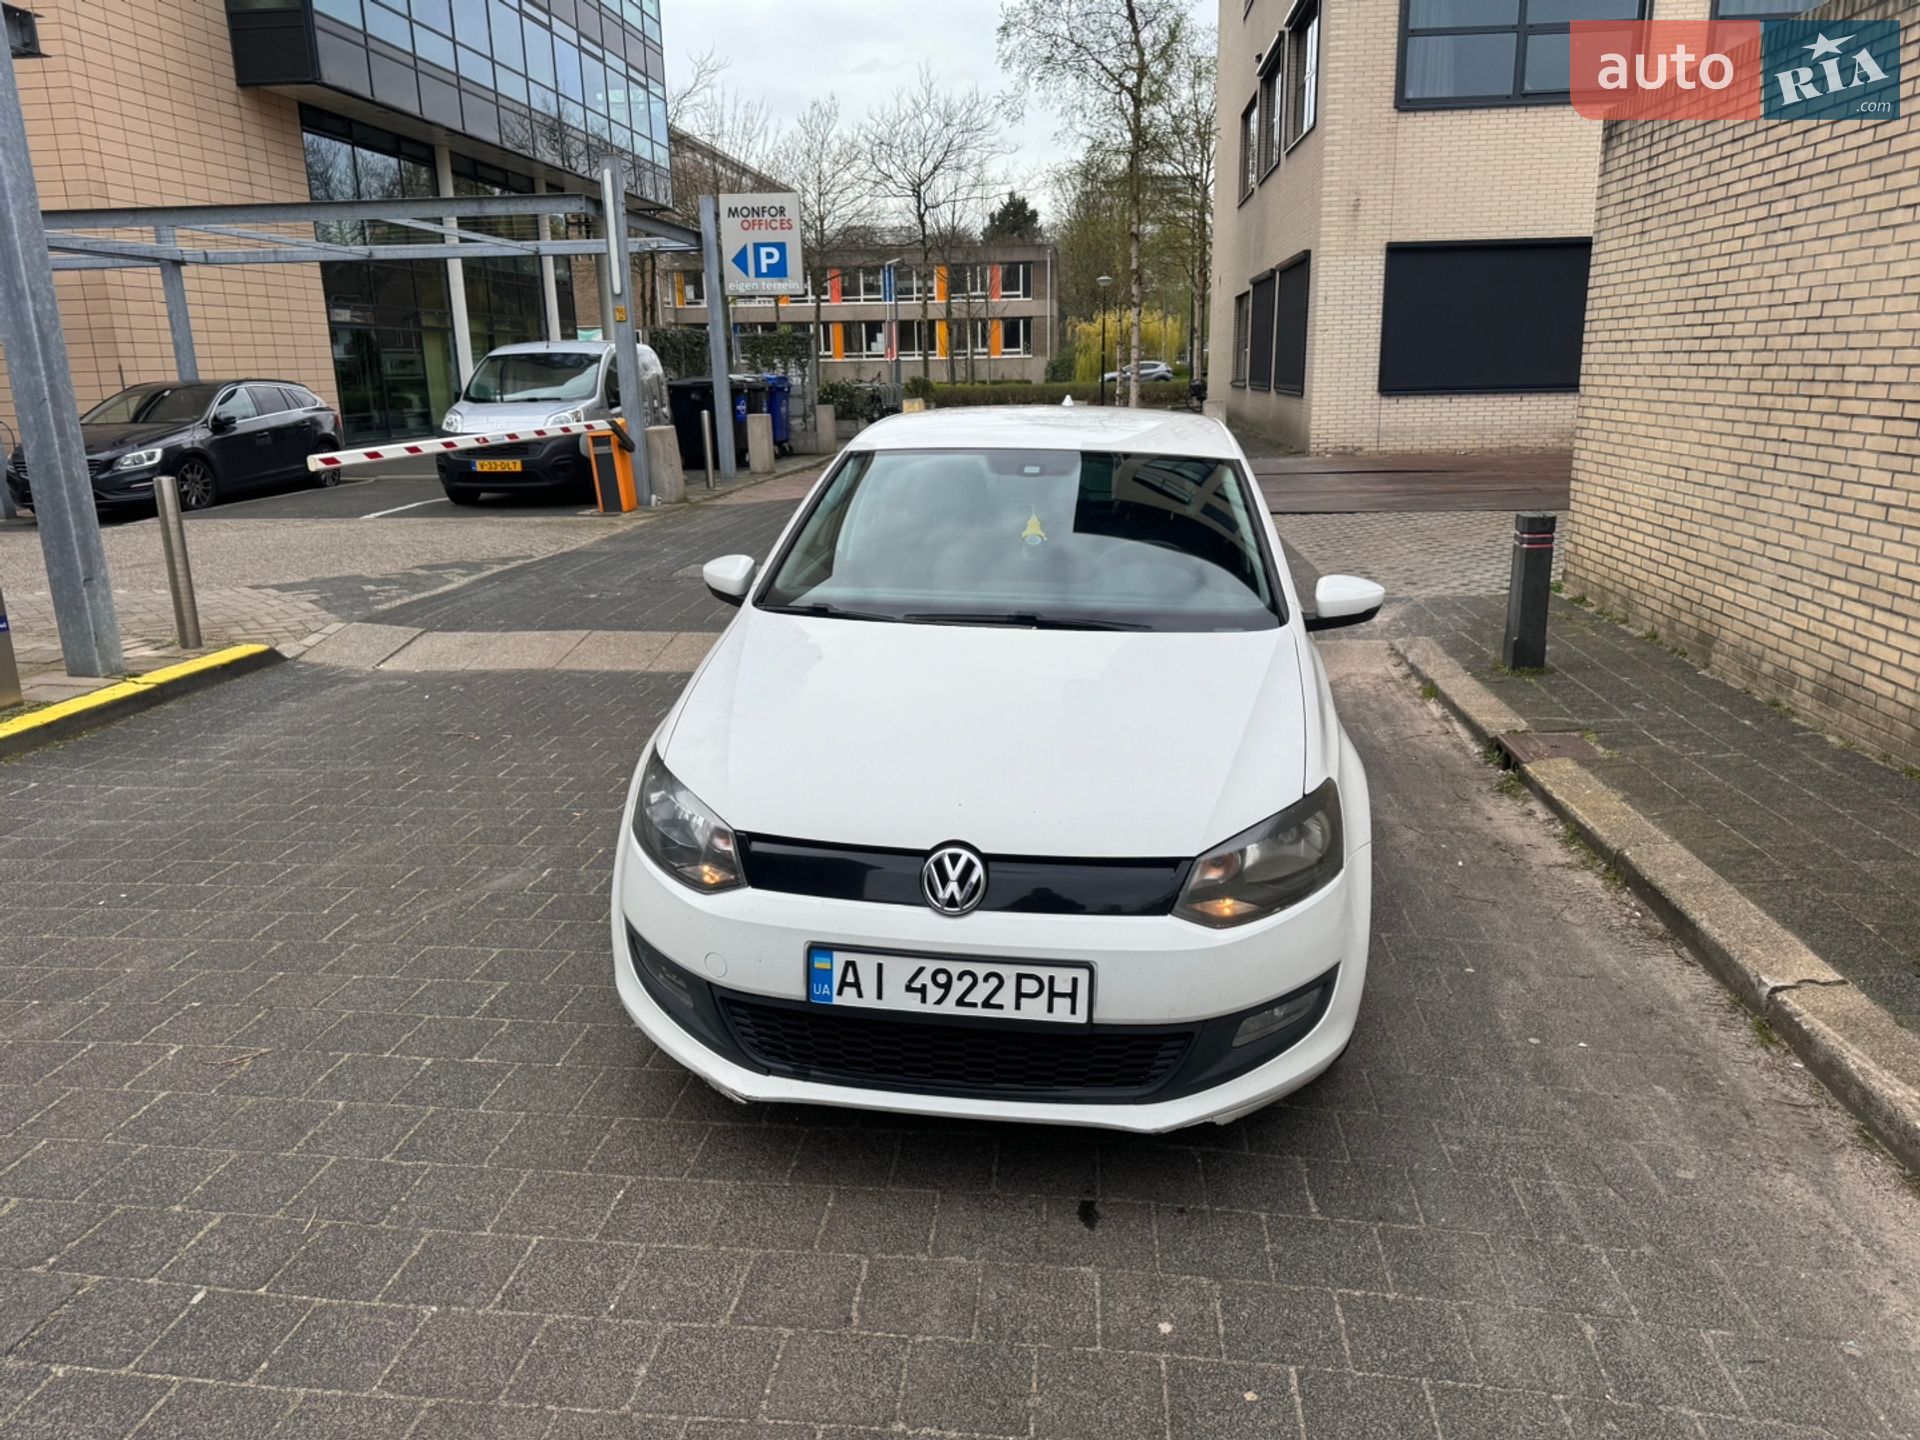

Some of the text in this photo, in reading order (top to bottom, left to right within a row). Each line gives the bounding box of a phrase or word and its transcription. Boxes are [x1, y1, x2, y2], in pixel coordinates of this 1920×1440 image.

[727, 206, 786, 218] MONFOR
[740, 218, 793, 231] OFFICES
[759, 246, 780, 273] P
[728, 279, 800, 293] eigen terrein
[813, 983, 831, 996] UA
